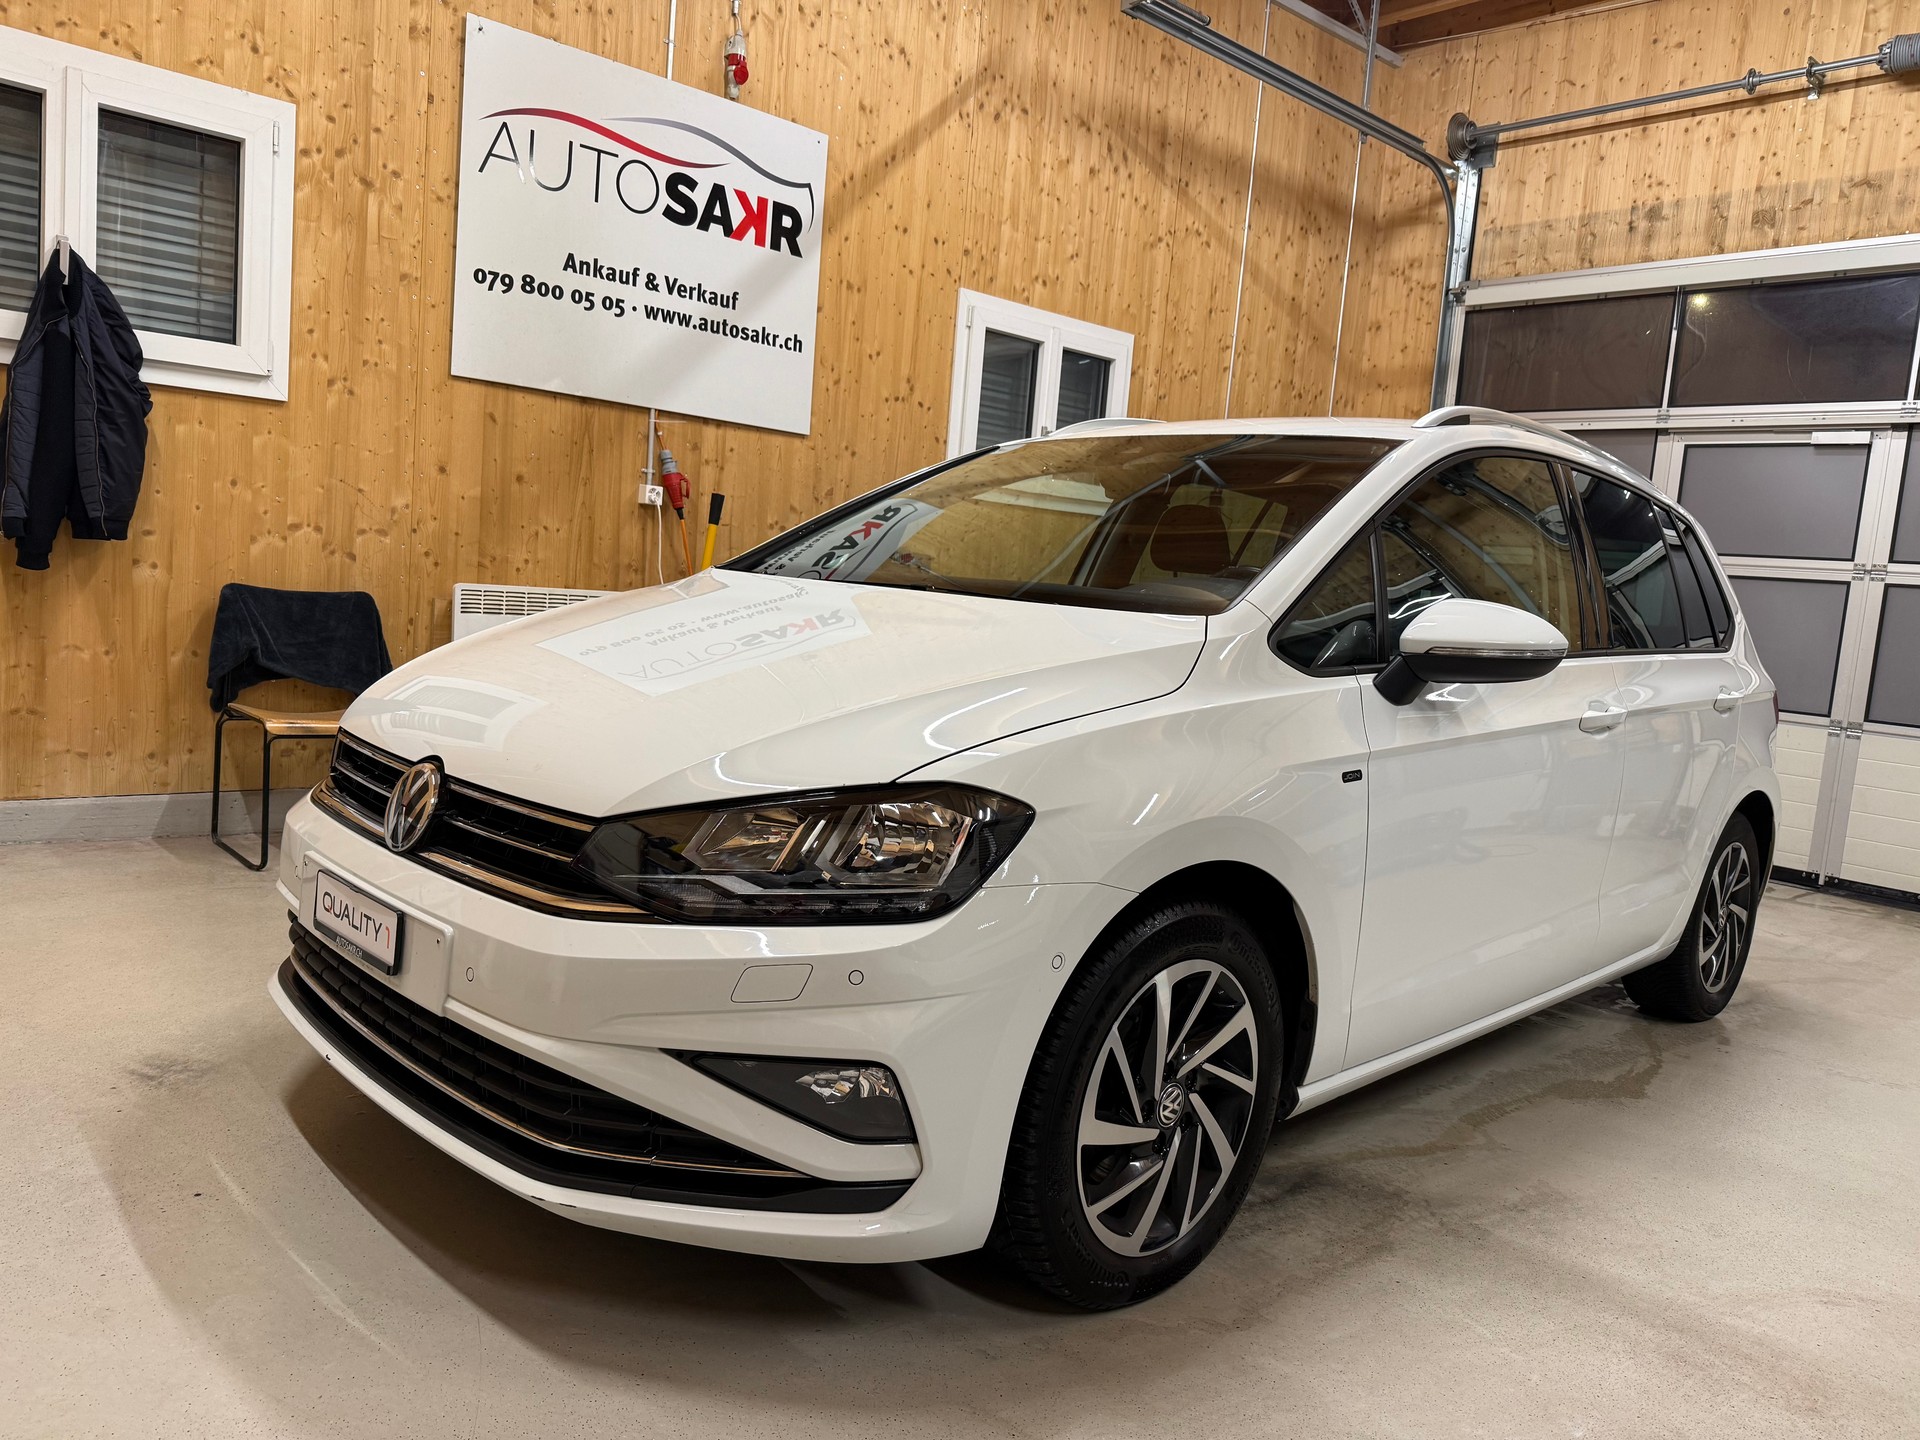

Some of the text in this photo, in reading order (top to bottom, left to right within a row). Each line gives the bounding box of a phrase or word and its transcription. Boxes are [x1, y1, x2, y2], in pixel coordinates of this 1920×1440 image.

[473, 267, 515, 295] 079
[520, 273, 565, 301] 800
[570, 288, 596, 312] 05
[601, 295, 626, 318] 05
[643, 304, 803, 354] www.autosakr.ch
[562, 252, 740, 311] Ankauf & Verkauf
[322, 891, 391, 949] QUALITY 1
